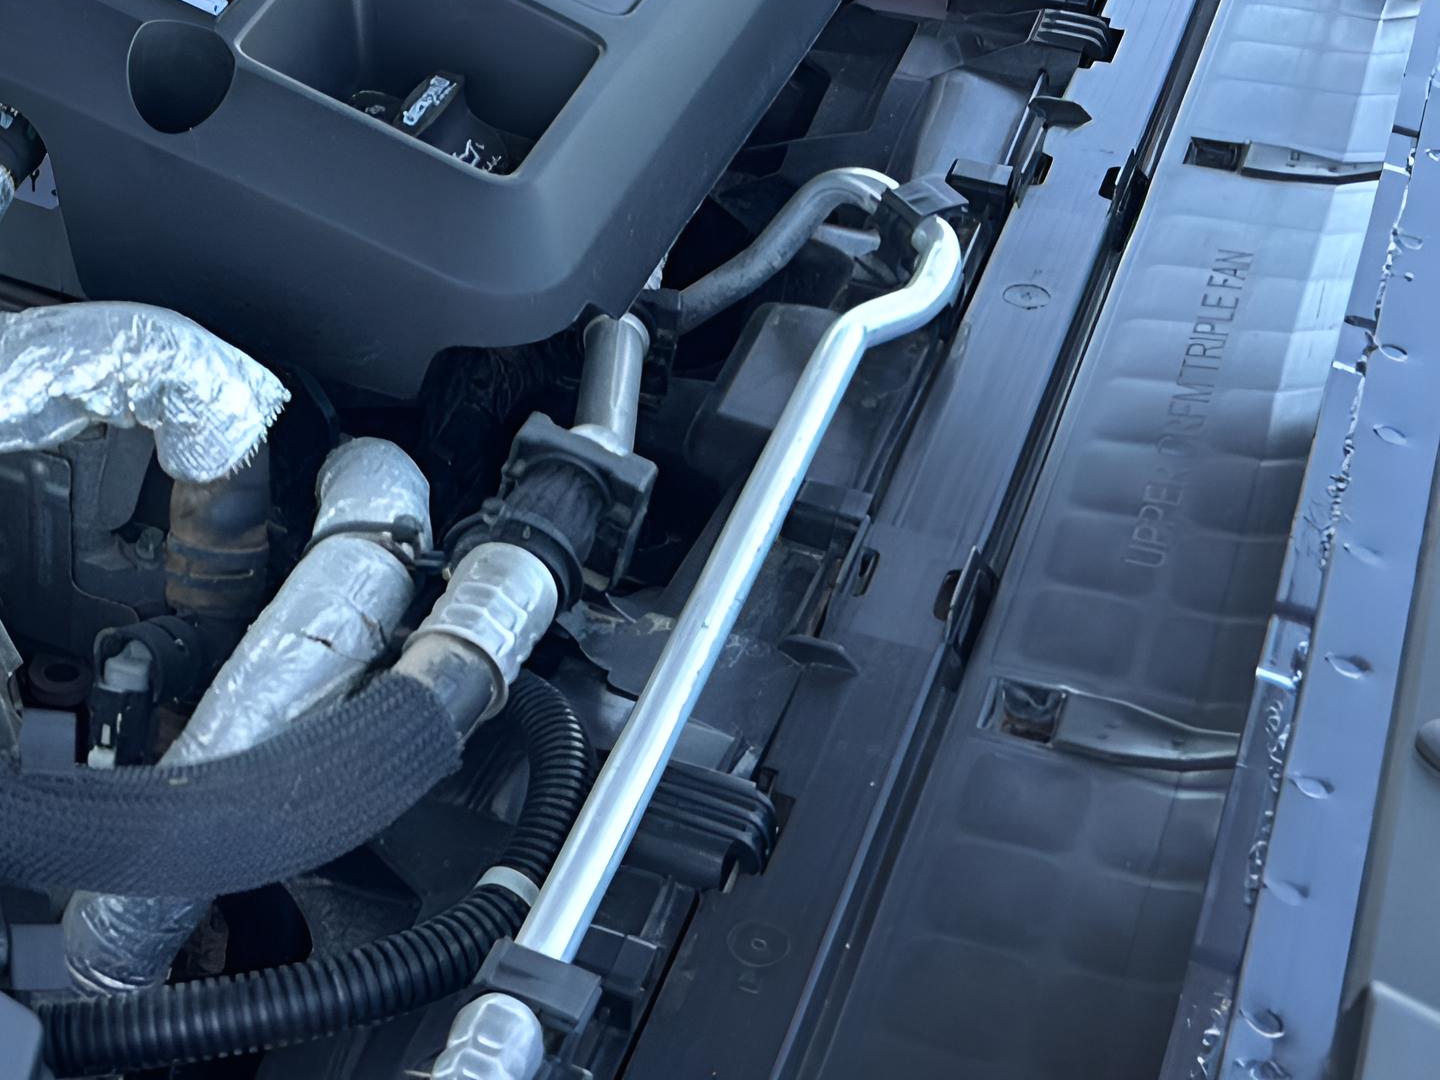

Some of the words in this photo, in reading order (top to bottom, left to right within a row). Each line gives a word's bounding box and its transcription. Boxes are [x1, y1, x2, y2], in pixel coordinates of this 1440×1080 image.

[1206, 248, 1255, 290] FAN
[1178, 293, 1240, 377] TRIPLE
[1123, 465, 1192, 568] UPPER
